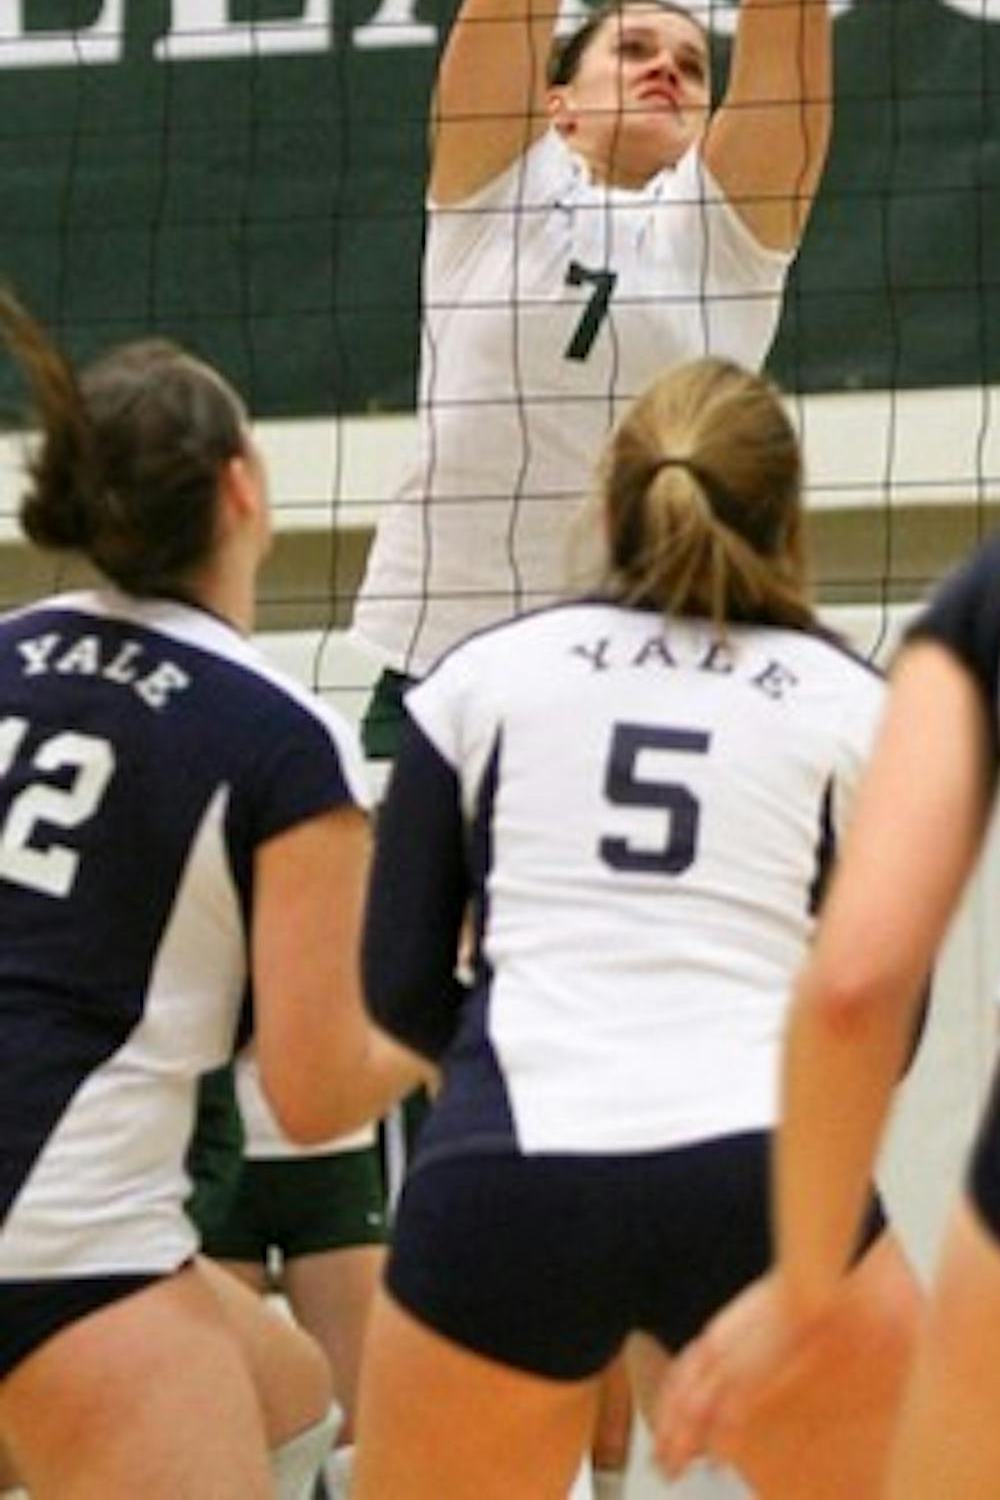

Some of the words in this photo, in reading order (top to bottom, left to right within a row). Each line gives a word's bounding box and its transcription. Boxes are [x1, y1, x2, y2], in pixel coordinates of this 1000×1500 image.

[564, 260, 617, 361] 7
[17, 633, 192, 708] YALE
[571, 636, 799, 699] YALE
[597, 722, 711, 876] 5
